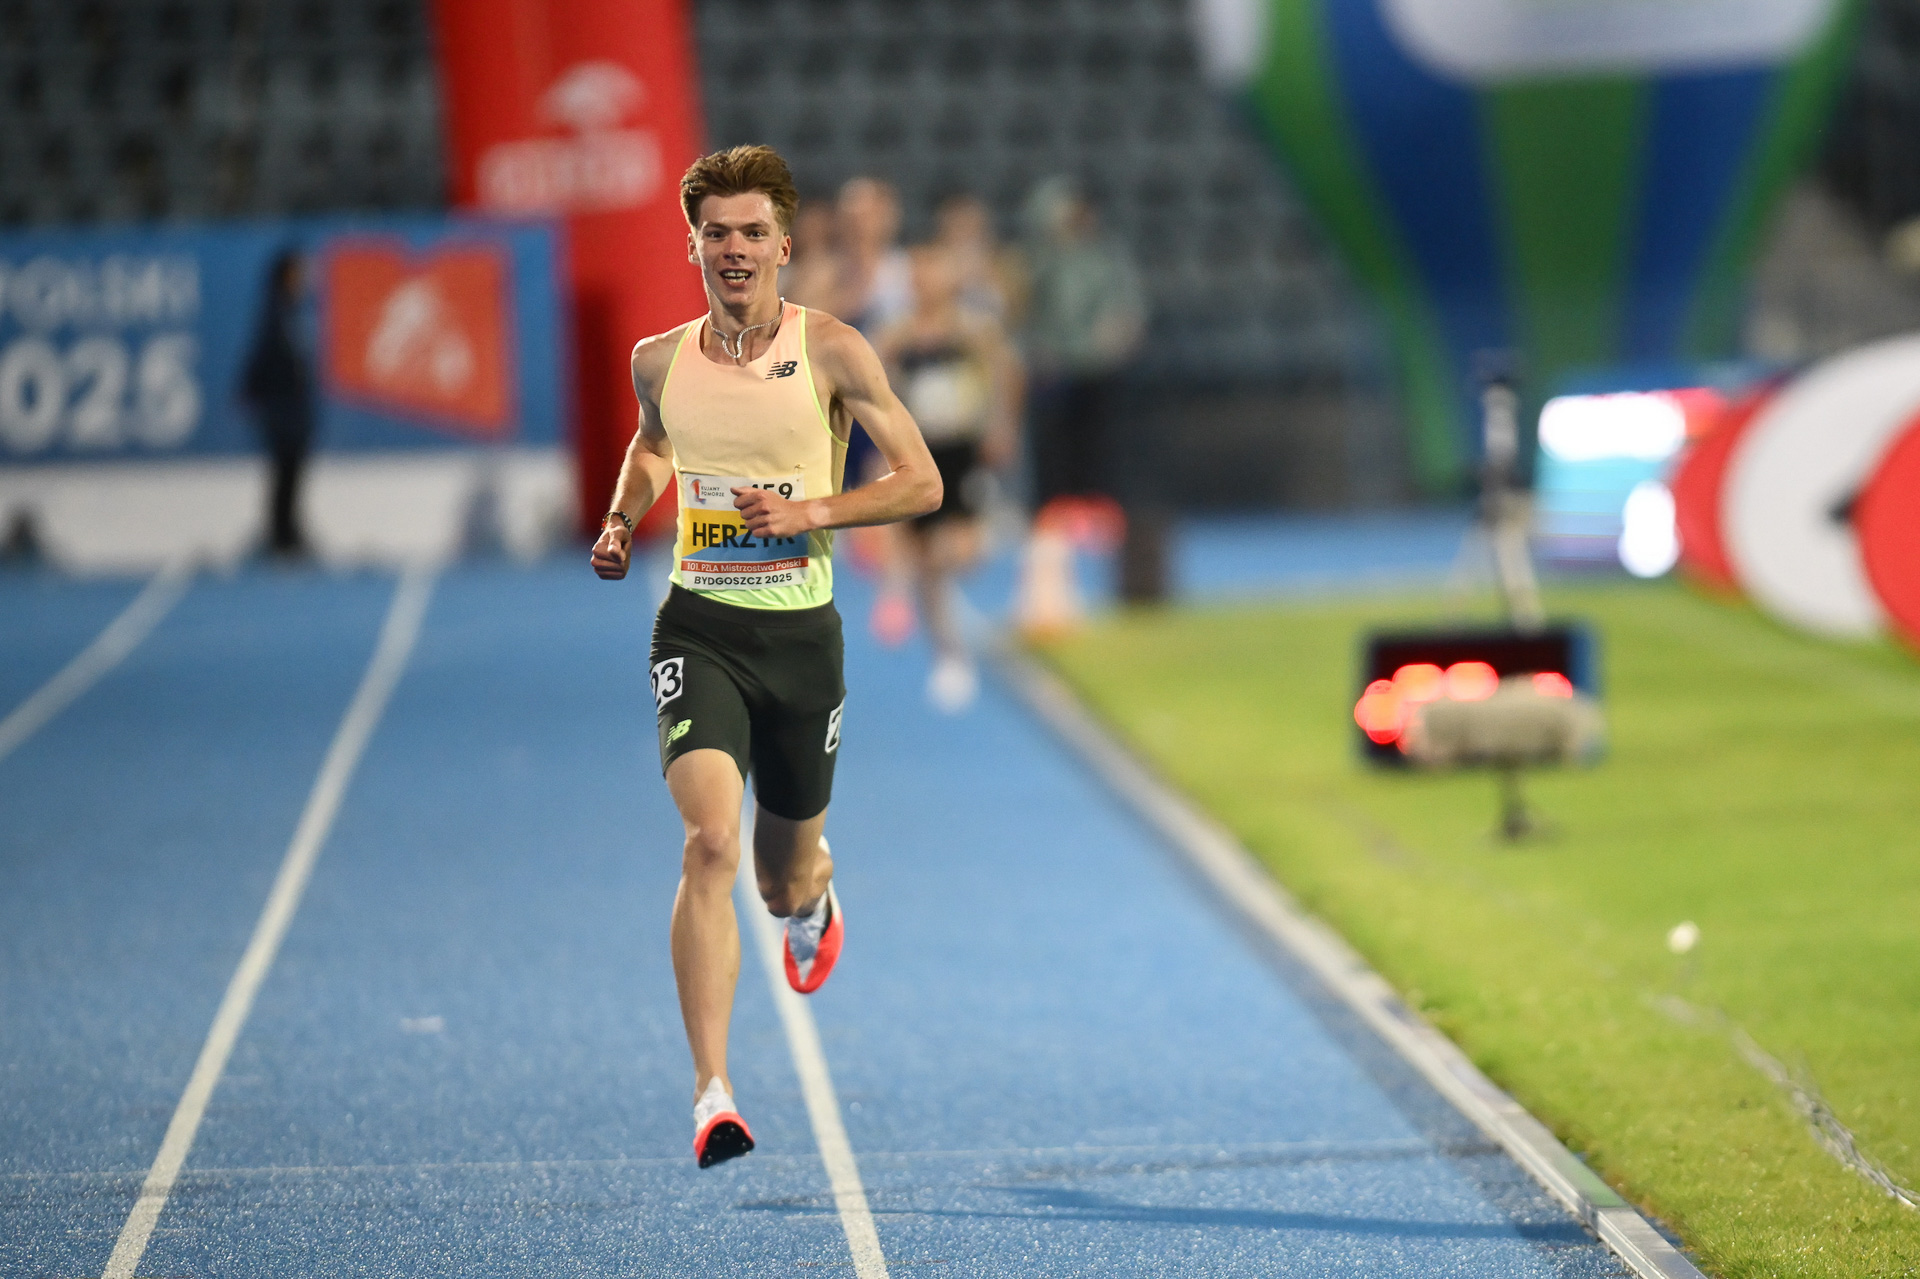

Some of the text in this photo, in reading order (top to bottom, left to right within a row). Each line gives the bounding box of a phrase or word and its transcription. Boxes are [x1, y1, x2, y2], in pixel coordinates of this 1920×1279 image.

[687, 559, 802, 572] 101. PZLA Mistrzostwa Polski
[694, 574, 793, 586] BYDGOSZCZ 2025
